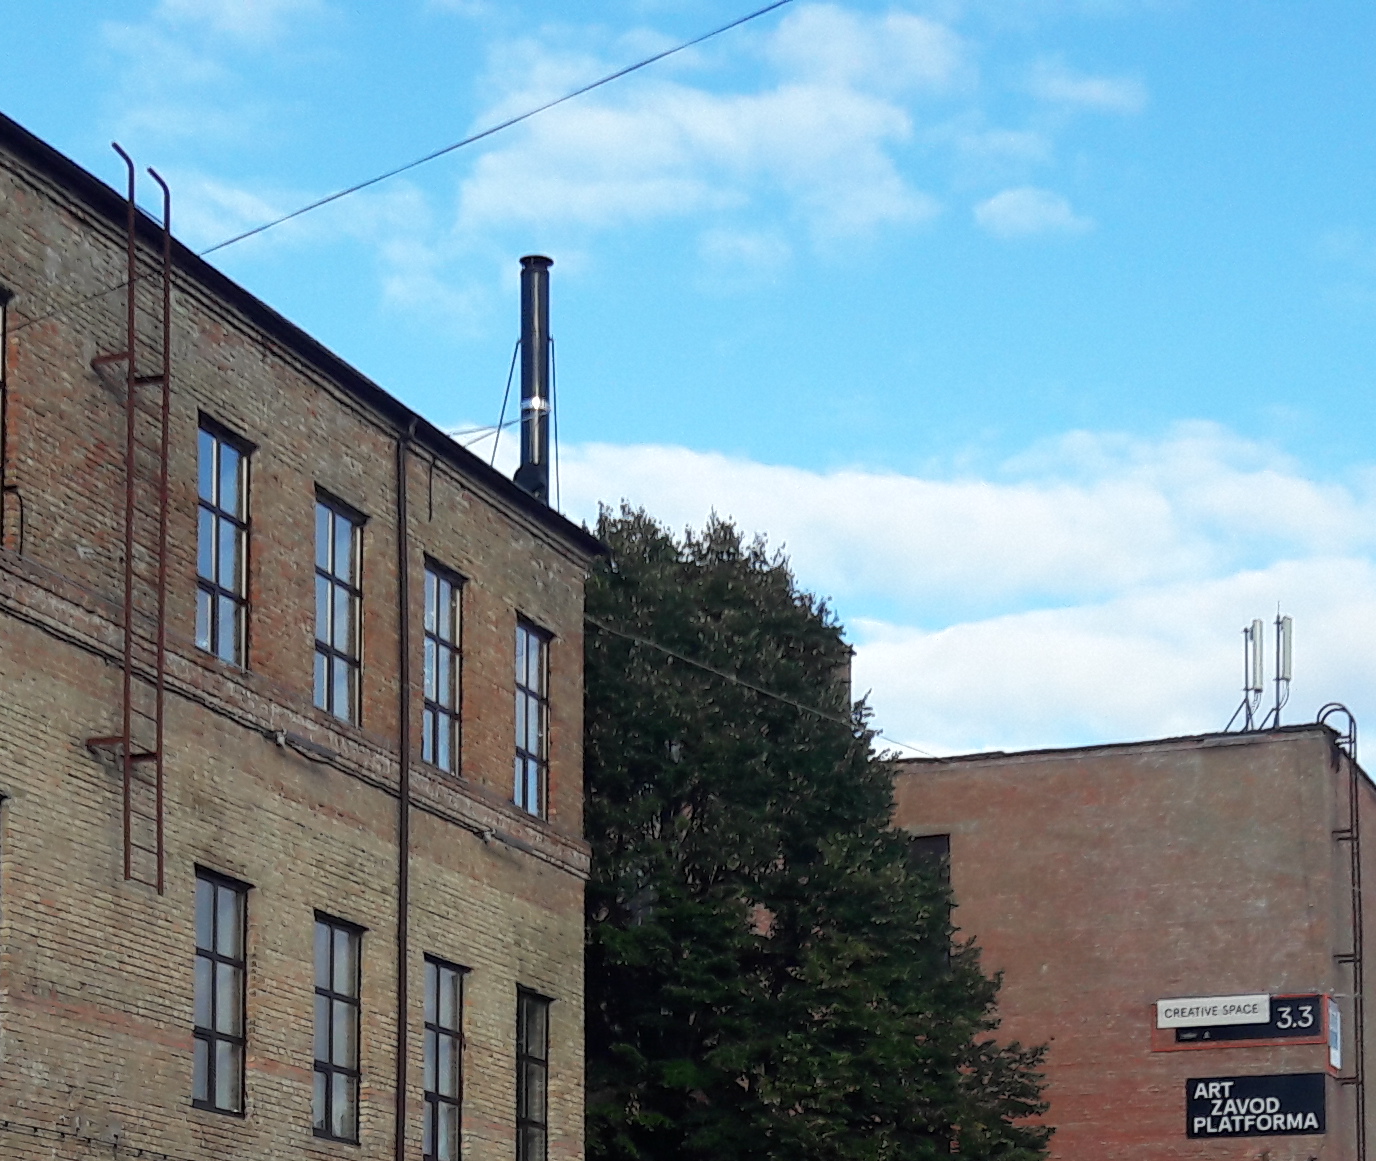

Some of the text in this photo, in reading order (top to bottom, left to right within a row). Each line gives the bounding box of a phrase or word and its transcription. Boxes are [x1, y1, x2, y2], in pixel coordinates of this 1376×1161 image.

[1164, 1002, 1259, 1019] CREATIVE SPACE
[1275, 1004, 1314, 1030] 3.3
[1193, 1080, 1234, 1100] ART
[1210, 1096, 1280, 1116] ZAVOD
[1193, 1112, 1319, 1134] PLATFORMA
